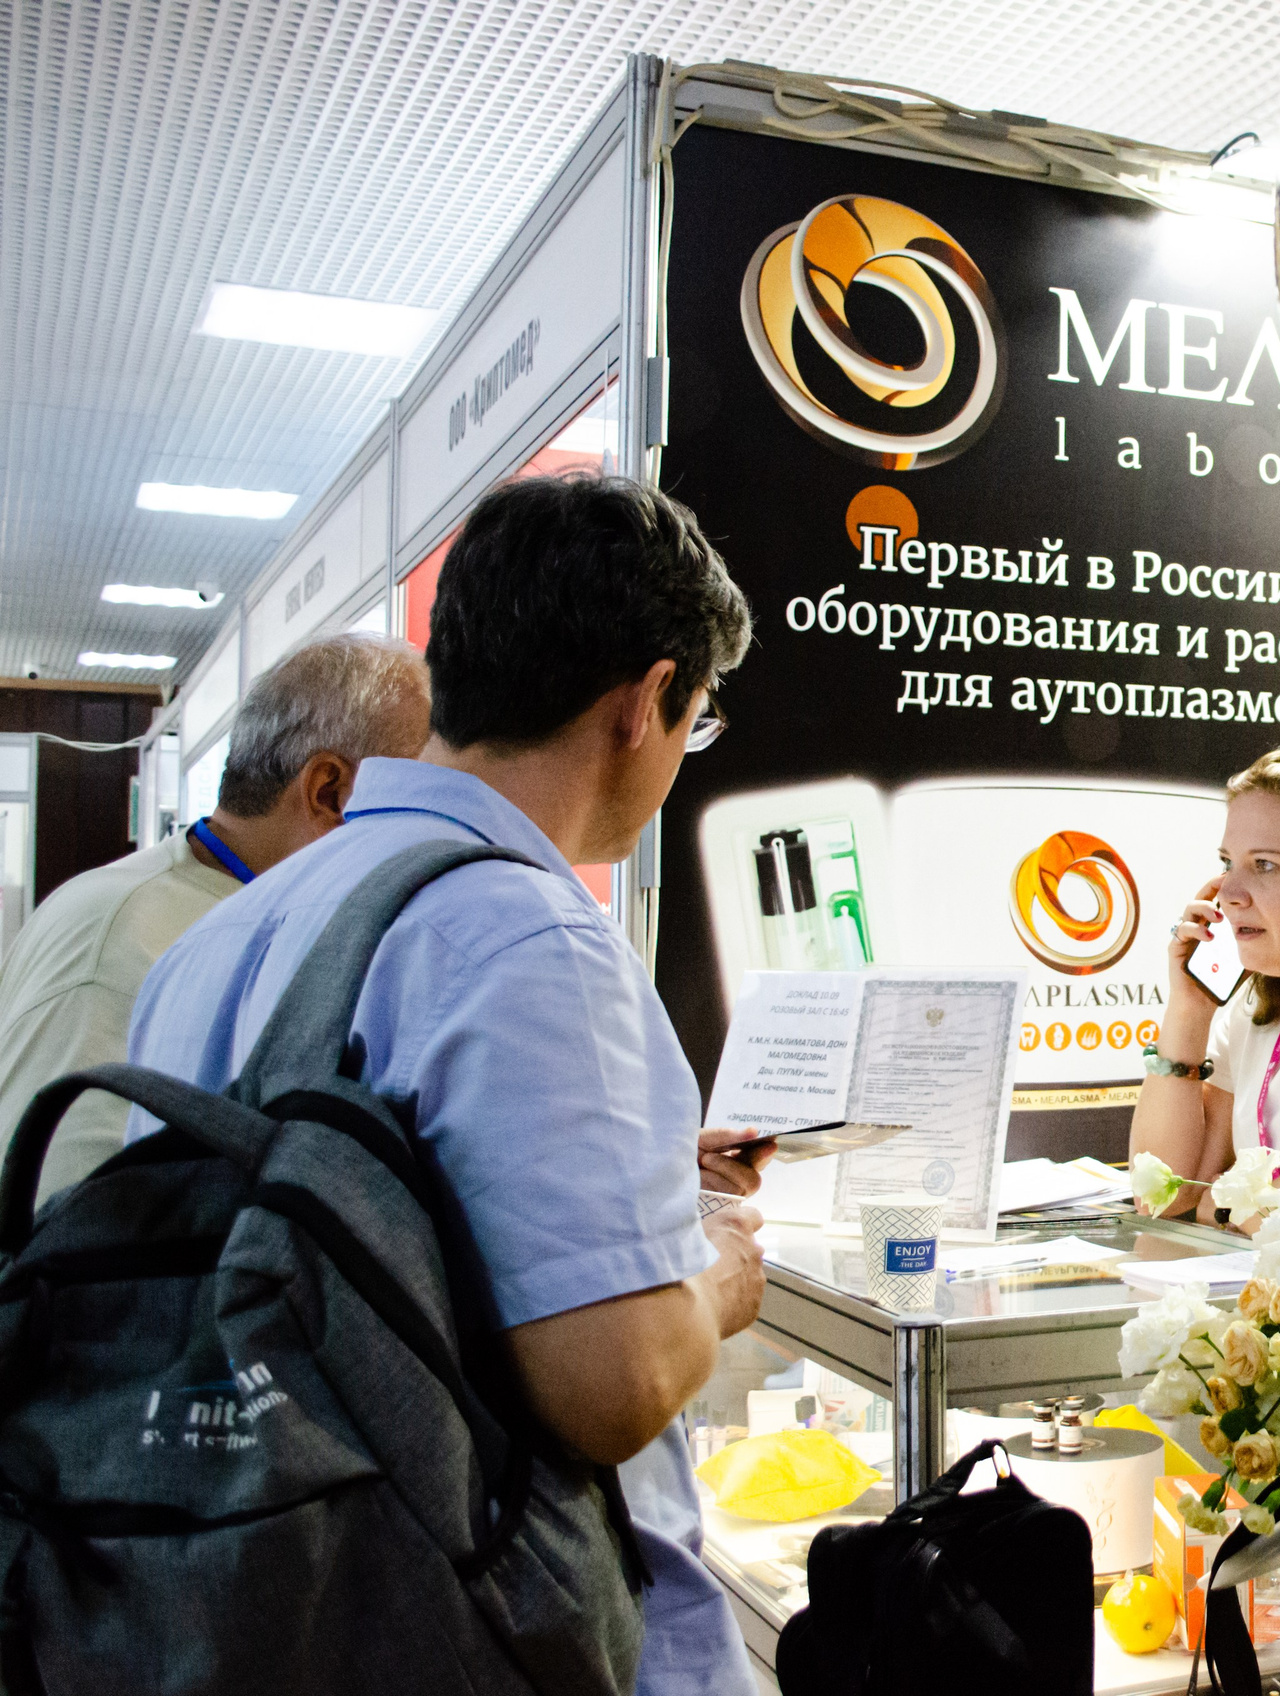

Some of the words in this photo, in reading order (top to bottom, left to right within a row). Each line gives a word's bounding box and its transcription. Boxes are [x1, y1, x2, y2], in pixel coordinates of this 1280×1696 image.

[859, 525, 1070, 588] Первый
[1086, 556, 1116, 590] в
[786, 583, 1160, 653] оборудования
[1176, 625, 1209, 659] и
[896, 670, 993, 714] для
[786, 990, 818, 999] ДОКЛАД
[819, 990, 840, 999] 10.09
[770, 1004, 806, 1015] РОЗОВЫЙ
[807, 1007, 823, 1015] ЗАЛ
[830, 1008, 849, 1016] 16:45
[767, 1050, 828, 1062] МАГОМЕДОВНА
[763, 1082, 797, 1093] Сеченова
[807, 1086, 836, 1095] Москва
[895, 1245, 931, 1256] ENJOY
